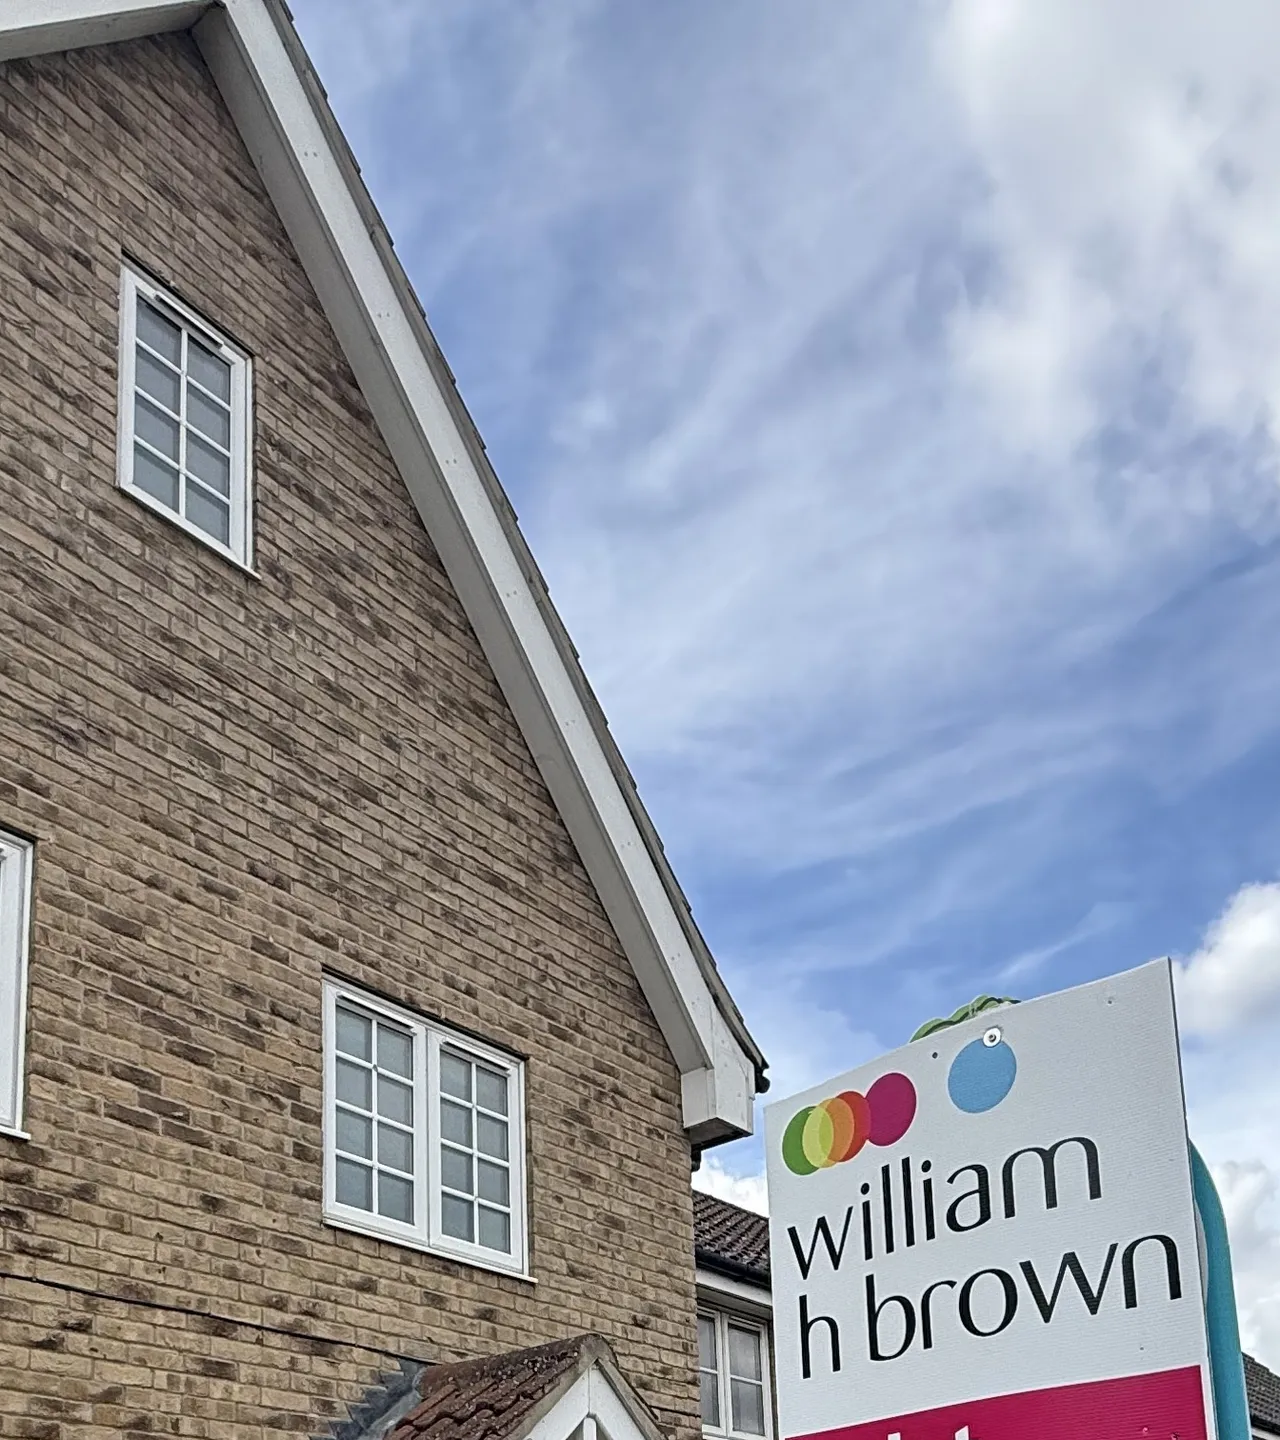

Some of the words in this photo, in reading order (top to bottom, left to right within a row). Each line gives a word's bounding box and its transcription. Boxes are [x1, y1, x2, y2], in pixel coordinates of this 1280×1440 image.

[787, 1136, 1102, 1280] william
[798, 1294, 842, 1380] h
[865, 1233, 1183, 1362] brown
